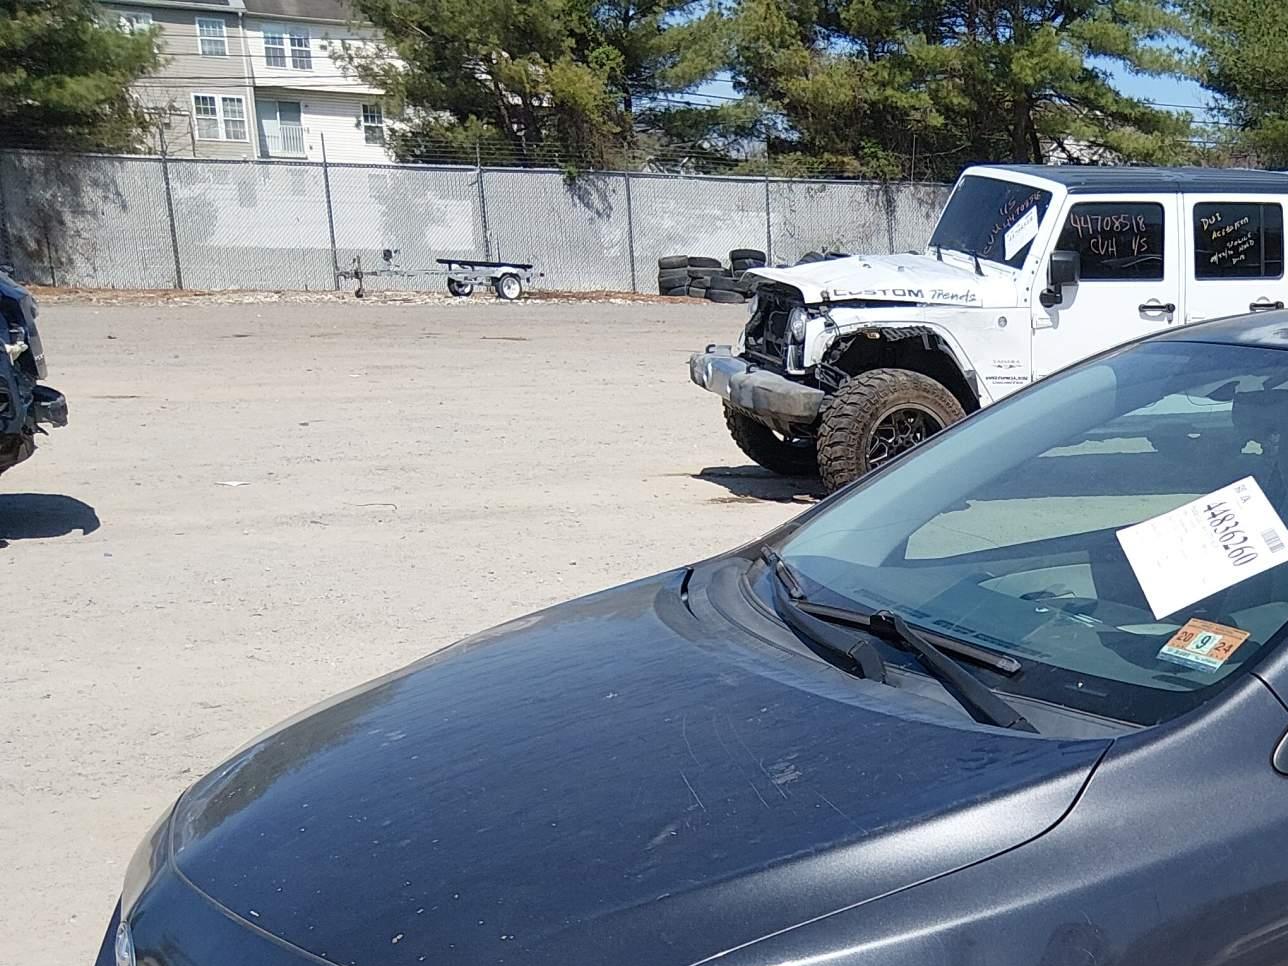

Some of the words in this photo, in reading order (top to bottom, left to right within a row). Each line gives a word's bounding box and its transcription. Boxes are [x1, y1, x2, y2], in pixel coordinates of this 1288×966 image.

[1070, 211, 1146, 239] 44708518
[1203, 501, 1258, 567] 44836260
[1176, 631, 1194, 643] 20
[1195, 635, 1211, 649] 9
[1215, 641, 1233, 654] 24
